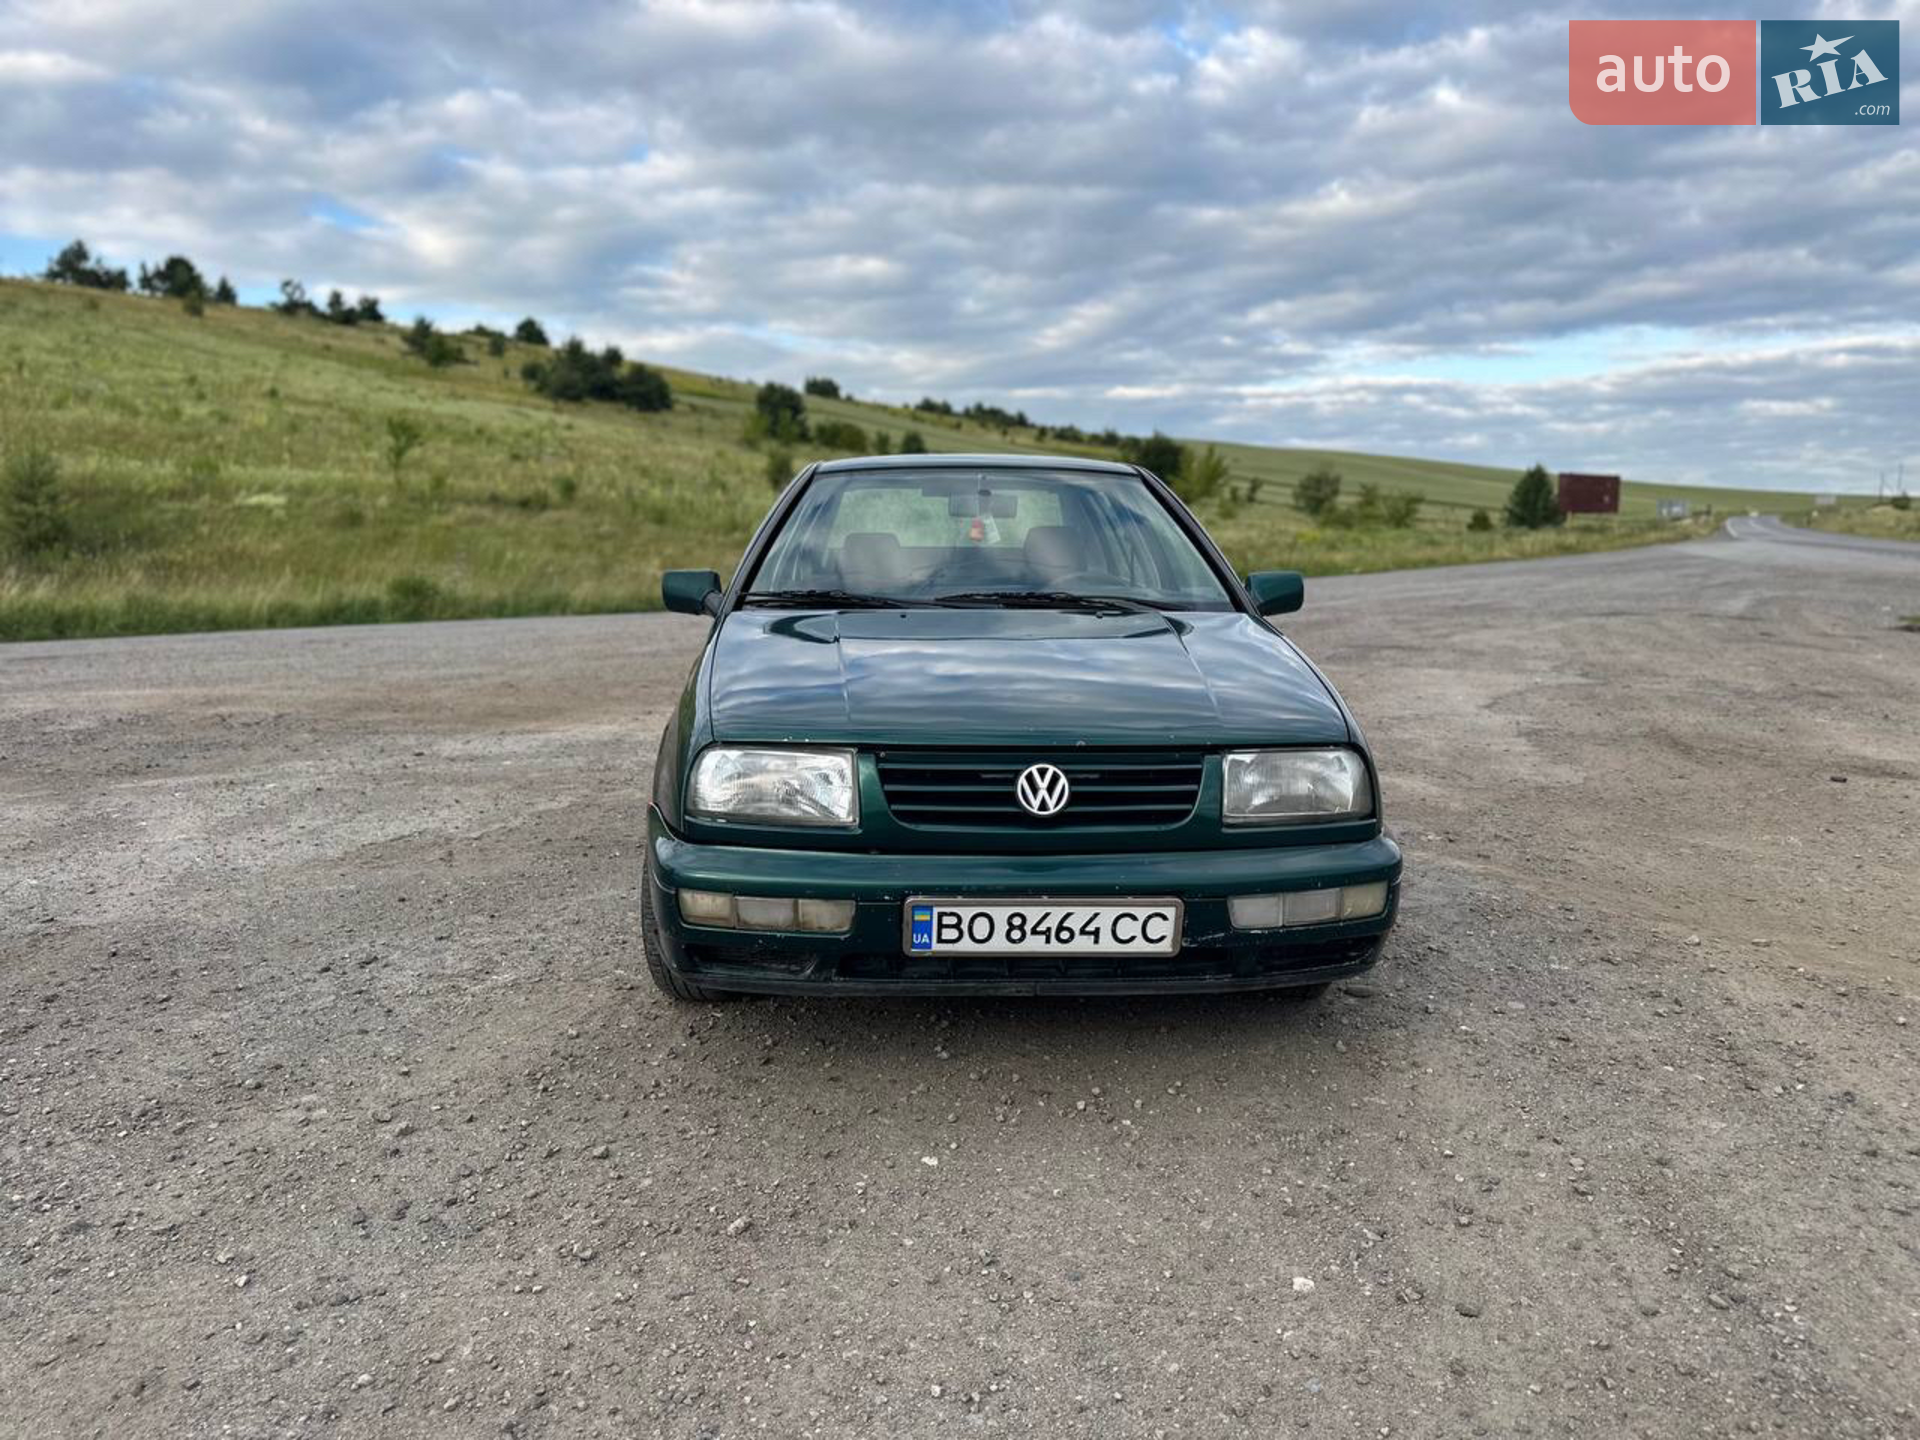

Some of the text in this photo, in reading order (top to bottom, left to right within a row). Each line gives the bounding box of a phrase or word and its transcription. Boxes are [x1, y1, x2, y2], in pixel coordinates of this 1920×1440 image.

[1018, 764, 1068, 814] VW
[912, 933, 930, 944] UA
[936, 911, 1170, 945] BO 8464 CC
